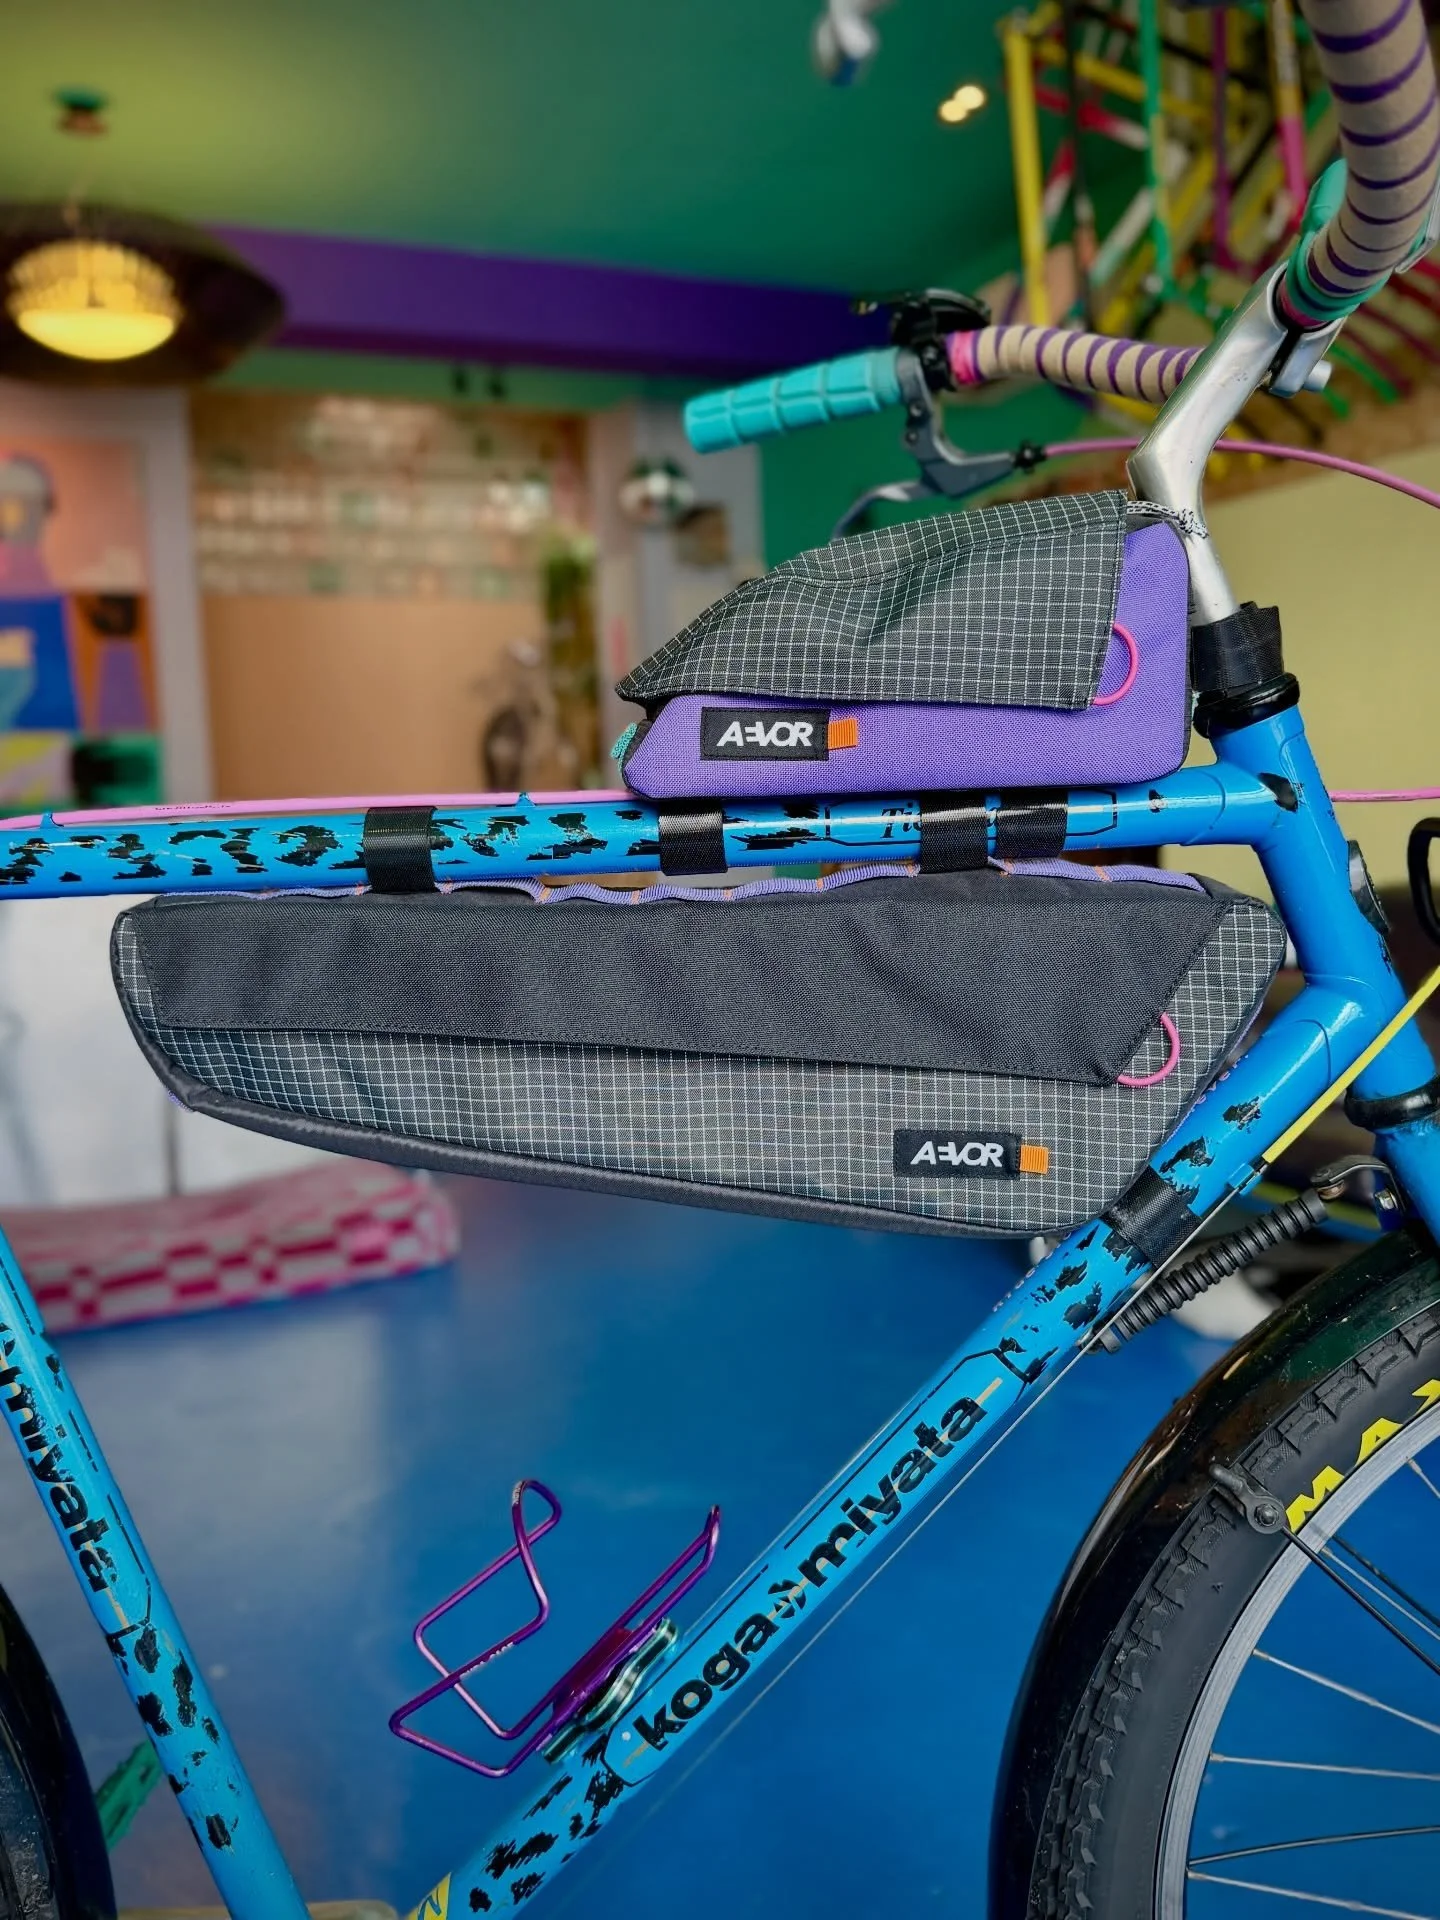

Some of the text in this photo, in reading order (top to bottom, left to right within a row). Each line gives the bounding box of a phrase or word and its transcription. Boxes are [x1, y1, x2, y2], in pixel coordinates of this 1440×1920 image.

[716, 721, 814, 747] AEVOR
[910, 1140, 1004, 1168] AEVOR
[632, 1396, 988, 1751] koga miyata
